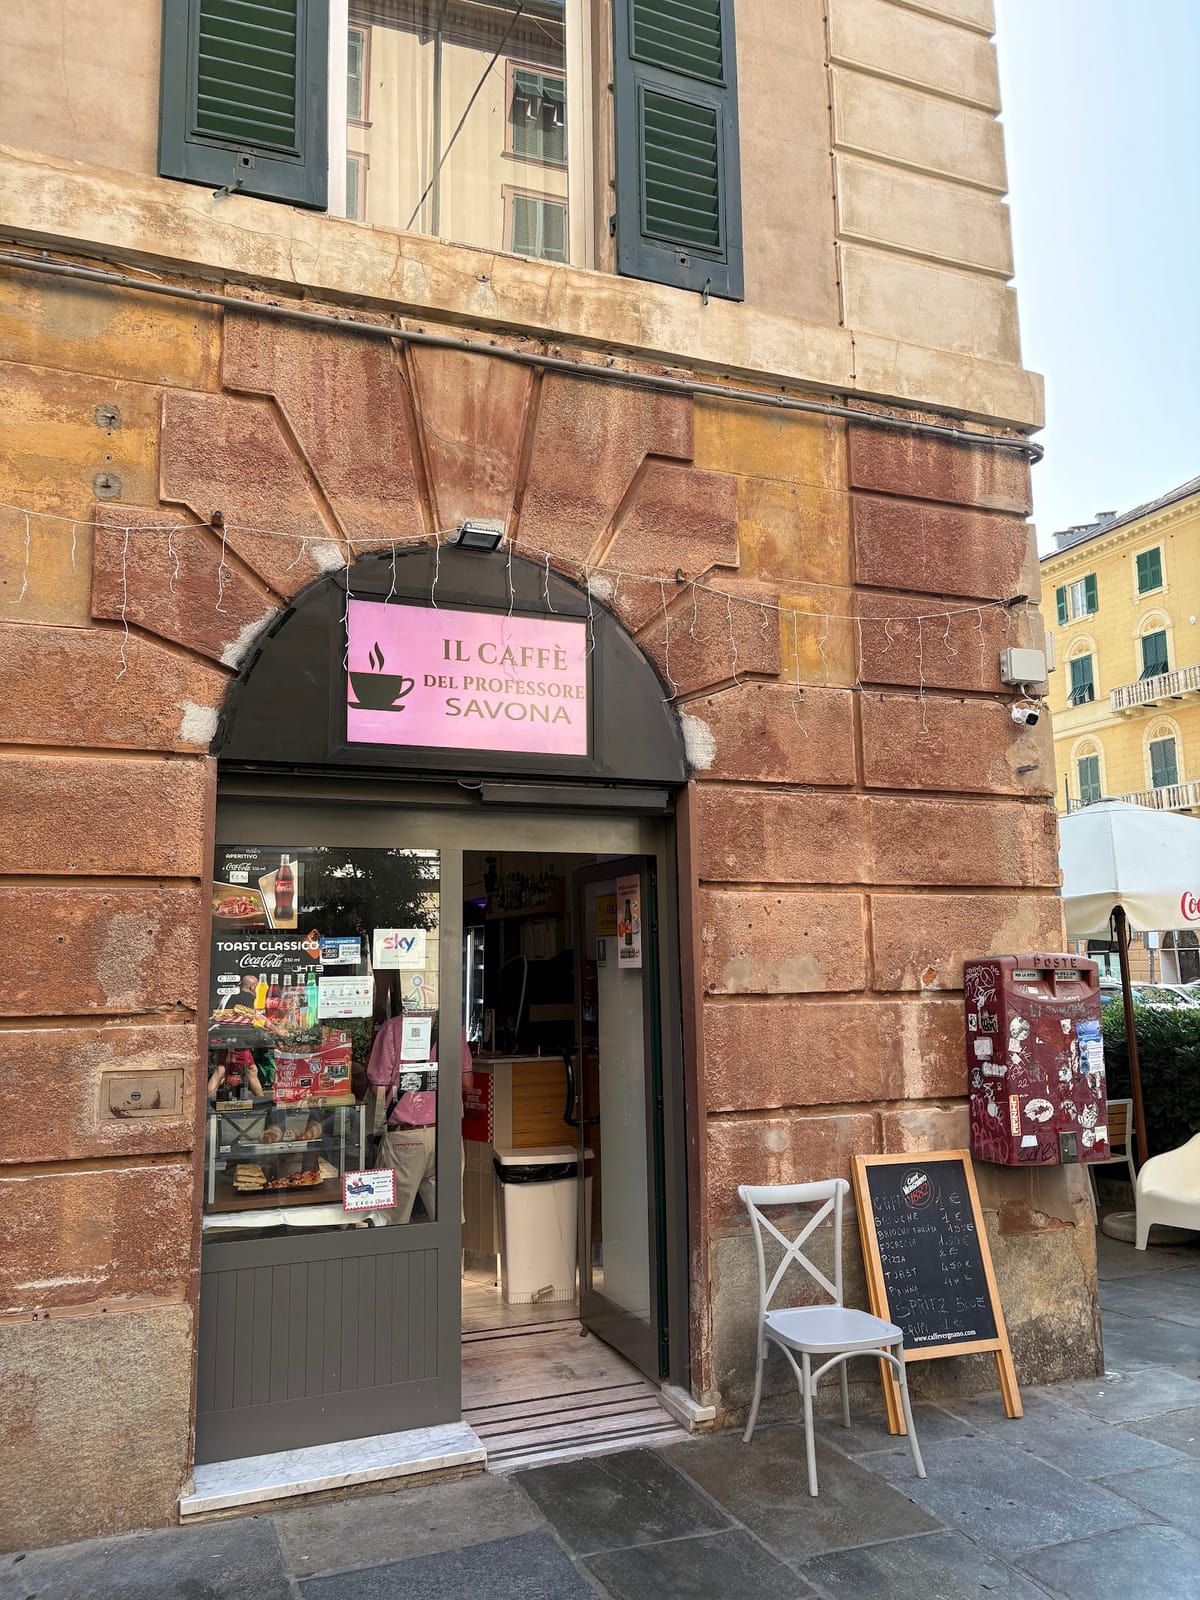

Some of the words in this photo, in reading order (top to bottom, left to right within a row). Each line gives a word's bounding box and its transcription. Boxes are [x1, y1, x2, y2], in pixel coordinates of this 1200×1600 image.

[442, 638, 470, 662] IL
[477, 642, 568, 671] CAFFÈ
[423, 674, 458, 690] DEL
[463, 676, 585, 700] PROFESSORE
[445, 697, 572, 724] SAVONA
[216, 942, 257, 951] TOAST
[259, 941, 320, 951] CLASSICO
[383, 933, 415, 953] sky
[239, 953, 285, 969] Coca-Cola
[1033, 957, 1078, 968] POSTE
[902, 1174, 928, 1195] VERGNANO
[910, 1182, 929, 1205] 1882
[884, 1267, 918, 1281] TOAST
[914, 1329, 977, 1342] www.caffevergnano.com
